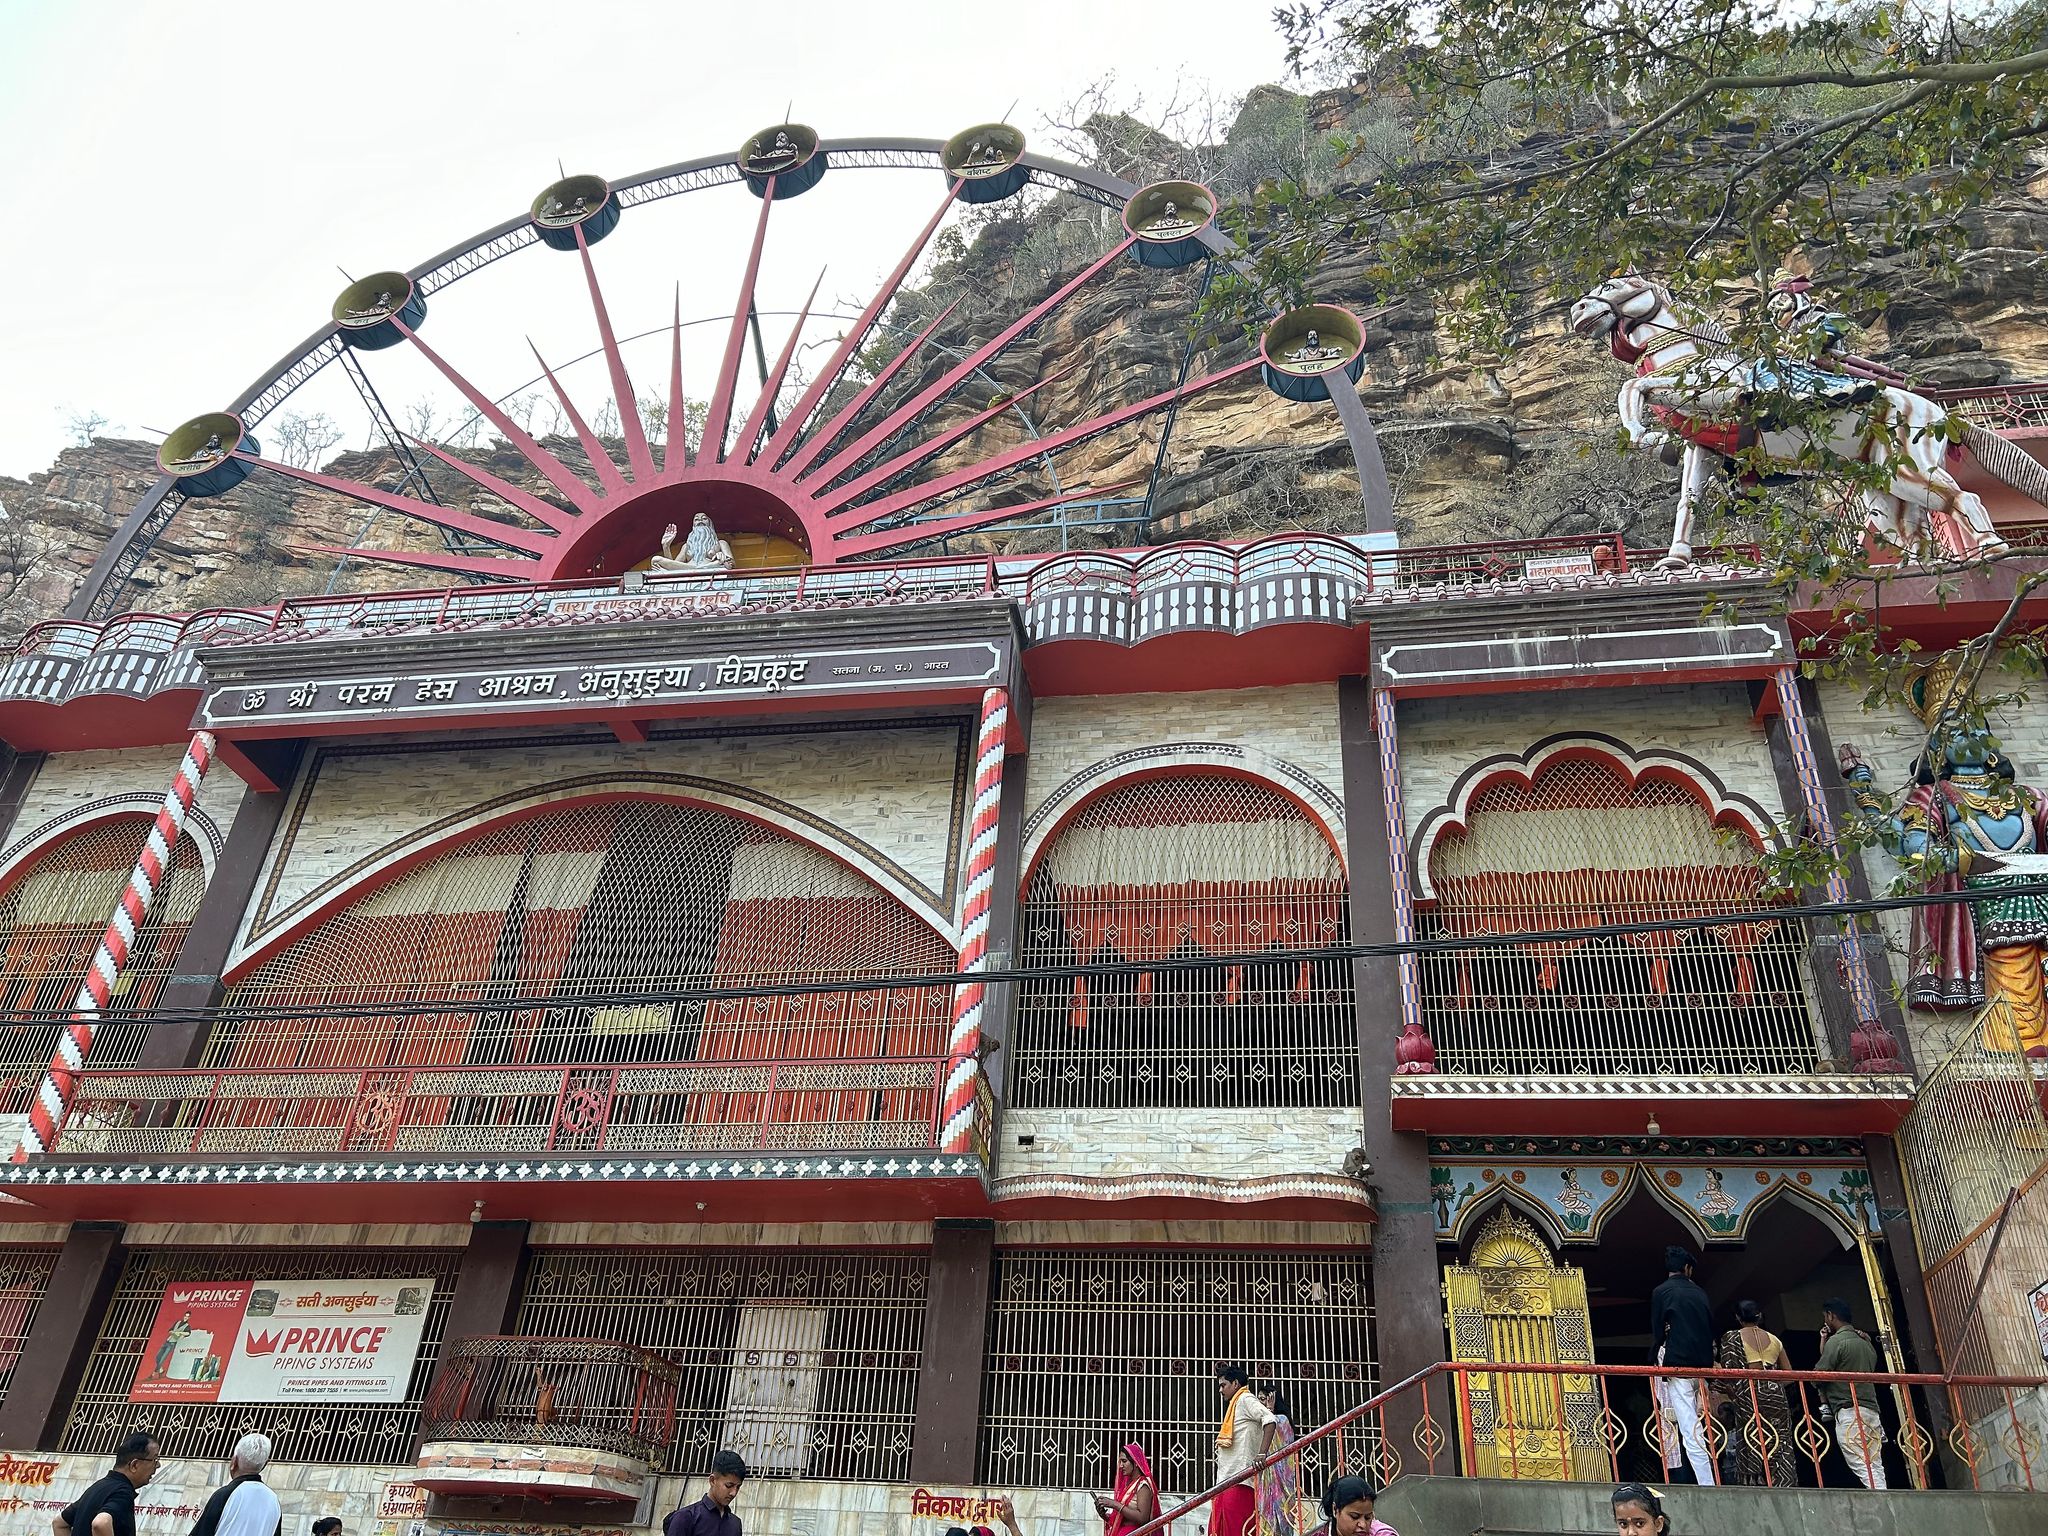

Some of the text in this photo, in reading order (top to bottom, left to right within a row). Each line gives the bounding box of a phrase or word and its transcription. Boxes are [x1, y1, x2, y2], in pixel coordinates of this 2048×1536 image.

[242, 689, 266, 711] ॐ
[287, 680, 318, 707] श्री
[338, 683, 396, 705] परम
[415, 676, 458, 702] हंस
[716, 654, 809, 692] चित्रकूट
[832, 666, 861, 676] सतना
[924, 661, 949, 670] भारत
[190, 1289, 244, 1302] PRINCE
[296, 1291, 322, 1307] सती
[280, 1327, 388, 1354] PRINCE
[273, 1357, 375, 1370] PIPING SYSTEMS
